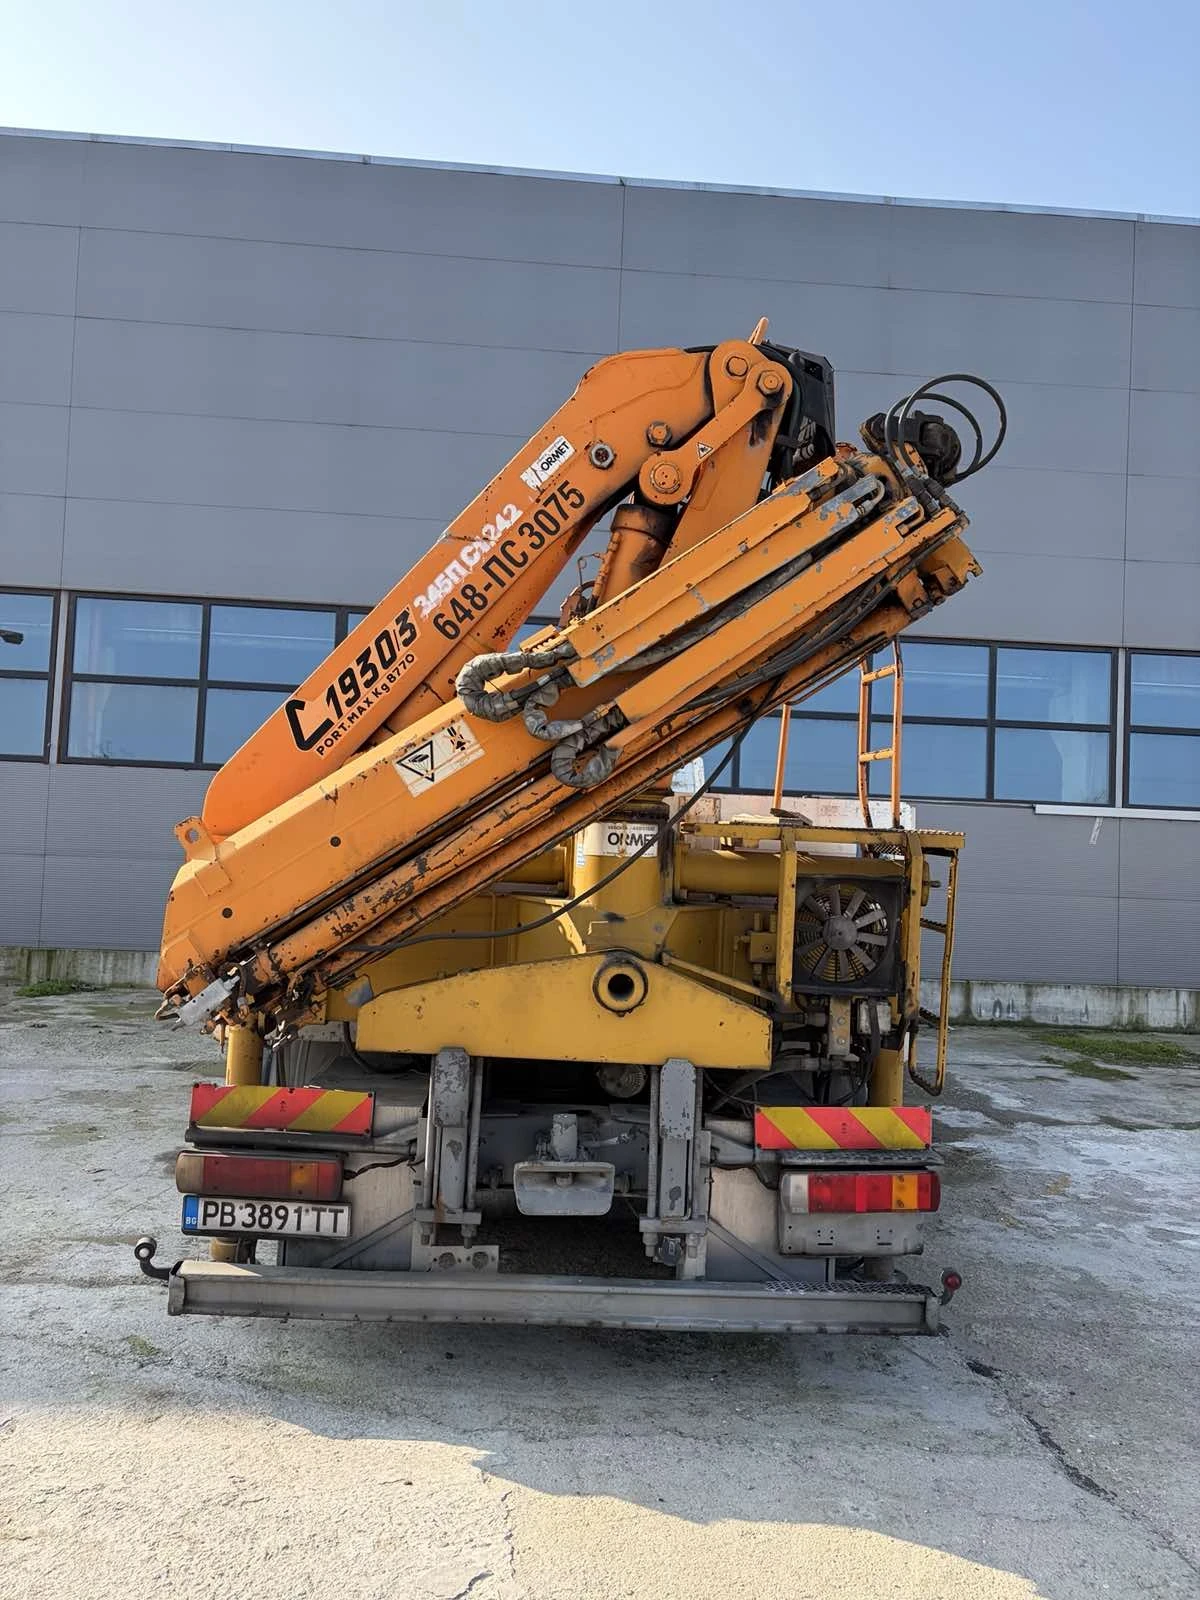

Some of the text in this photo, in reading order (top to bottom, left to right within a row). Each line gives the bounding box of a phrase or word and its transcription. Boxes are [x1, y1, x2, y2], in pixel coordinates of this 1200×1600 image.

[541, 441, 569, 471] ORMET
[518, 480, 585, 550] 3075
[386, 653, 415, 684] 8770
[185, 1216, 197, 1225] BG
